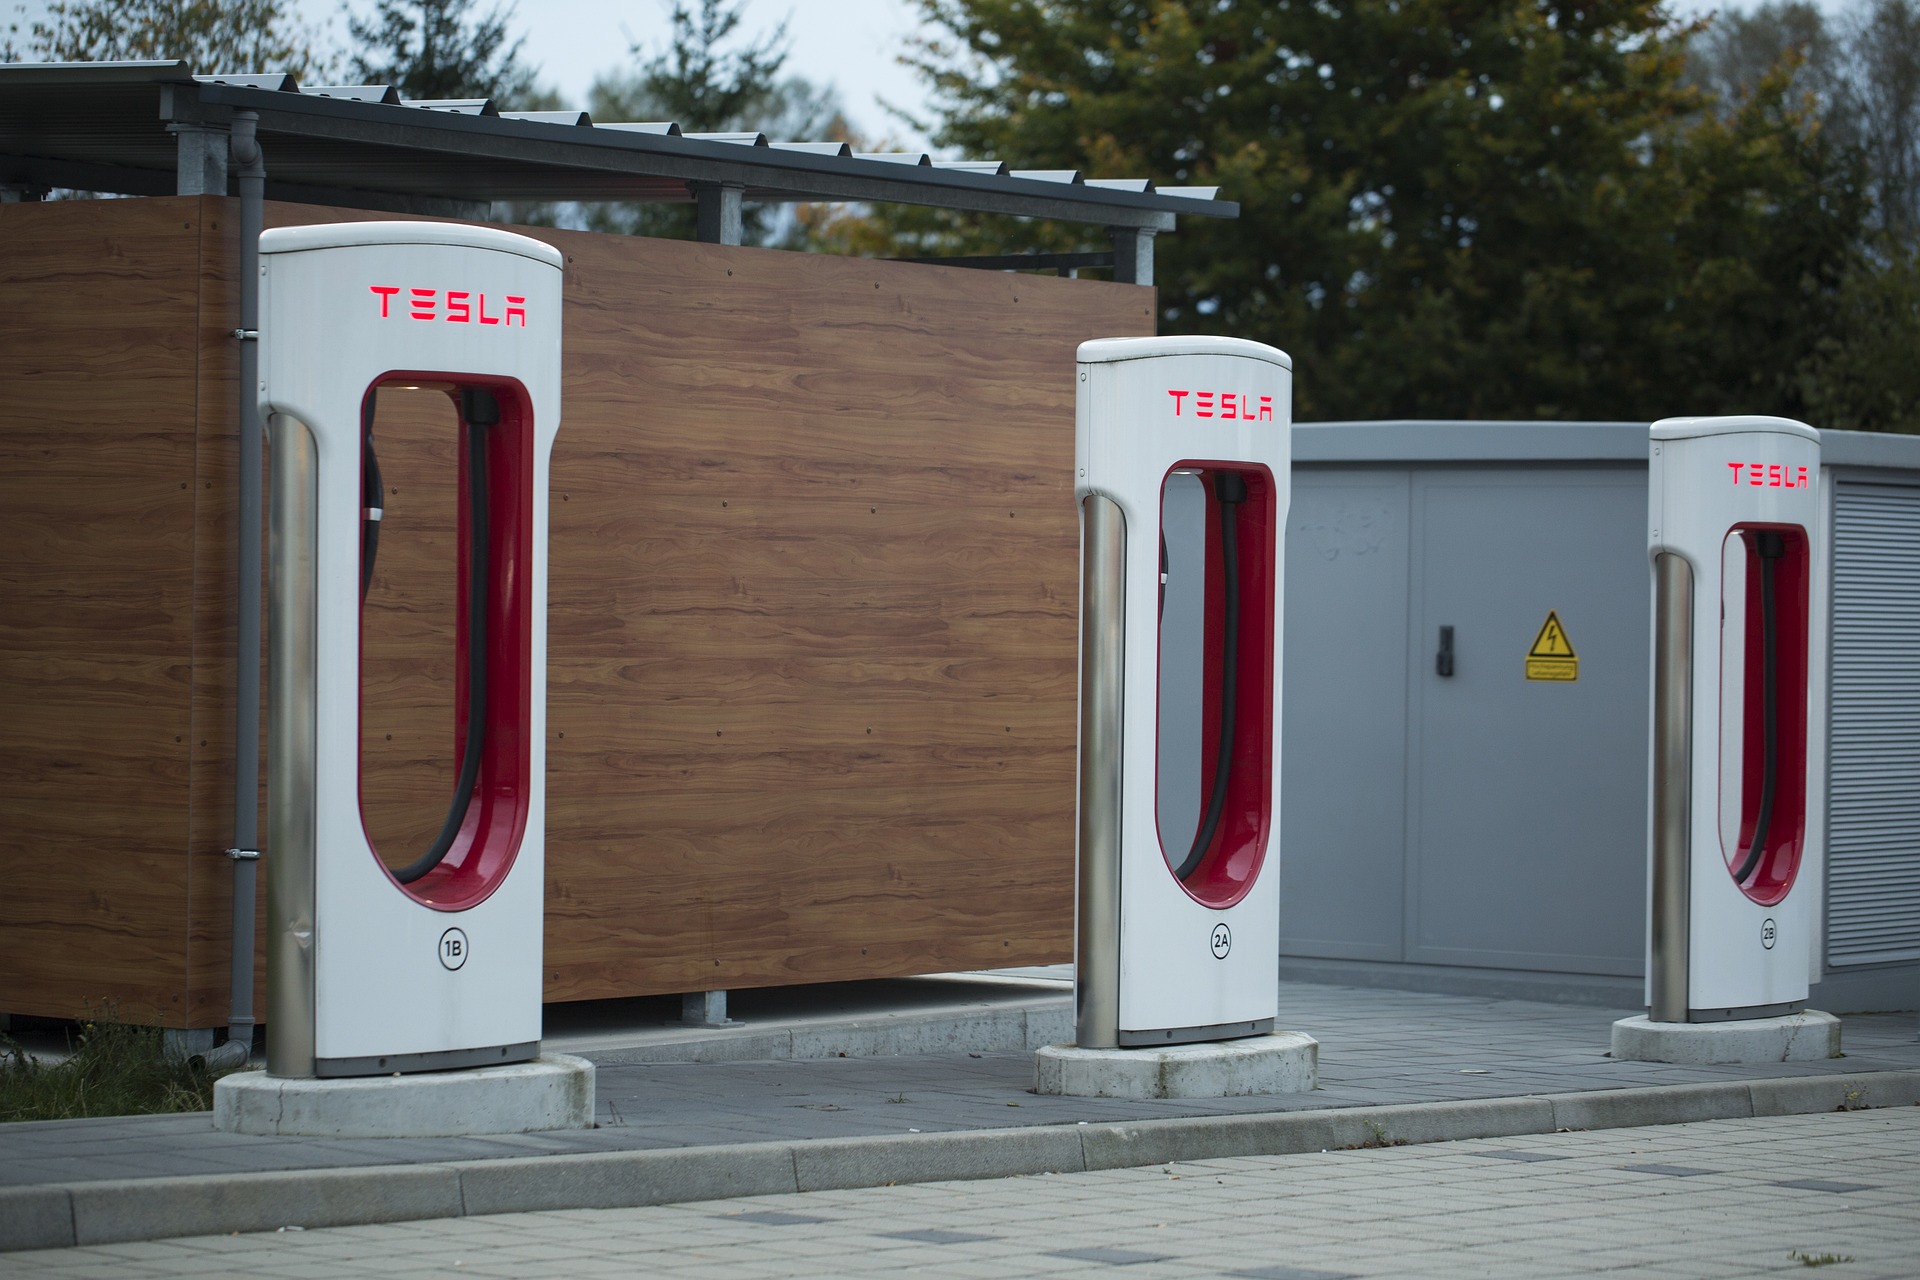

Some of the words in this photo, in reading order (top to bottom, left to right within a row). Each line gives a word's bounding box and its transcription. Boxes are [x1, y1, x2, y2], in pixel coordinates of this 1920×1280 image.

[369, 286, 526, 327] TESLA
[1168, 390, 1273, 421] TESLA
[1728, 462, 1808, 489] TESLA
[1214, 933, 1229, 948] 2A
[1763, 927, 1774, 940] 2B
[445, 940, 462, 957] 1B
